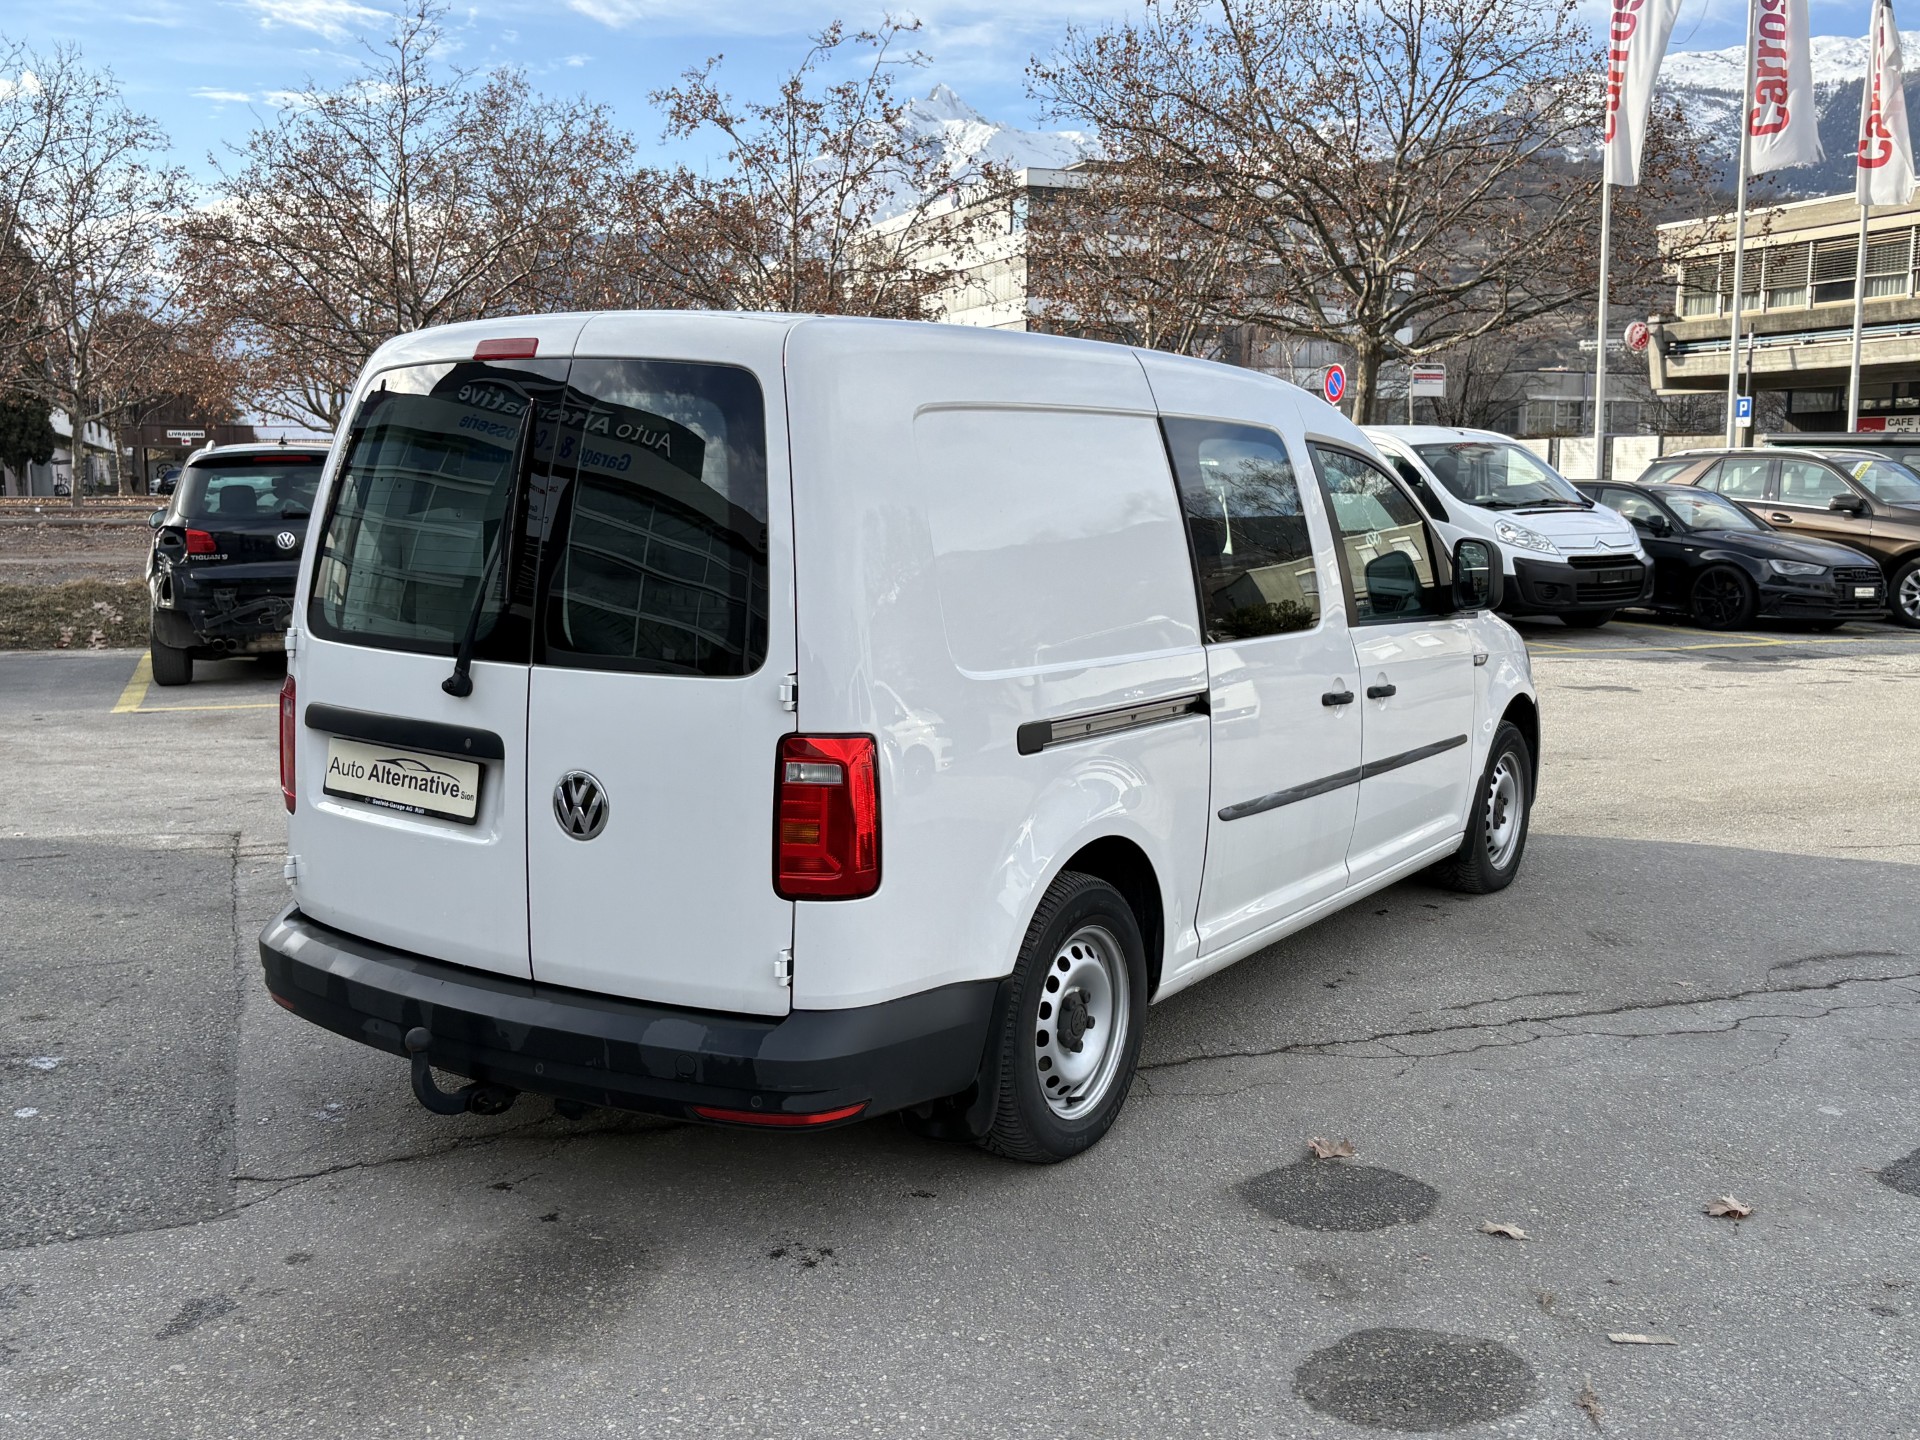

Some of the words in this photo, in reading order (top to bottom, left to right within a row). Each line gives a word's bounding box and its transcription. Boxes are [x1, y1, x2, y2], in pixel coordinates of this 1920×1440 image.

[1740, 401, 1748, 417] P
[1887, 417, 1914, 427] CAFE
[328, 756, 365, 780] Auto
[367, 763, 460, 799] Alternative
[460, 790, 475, 801] Sion
